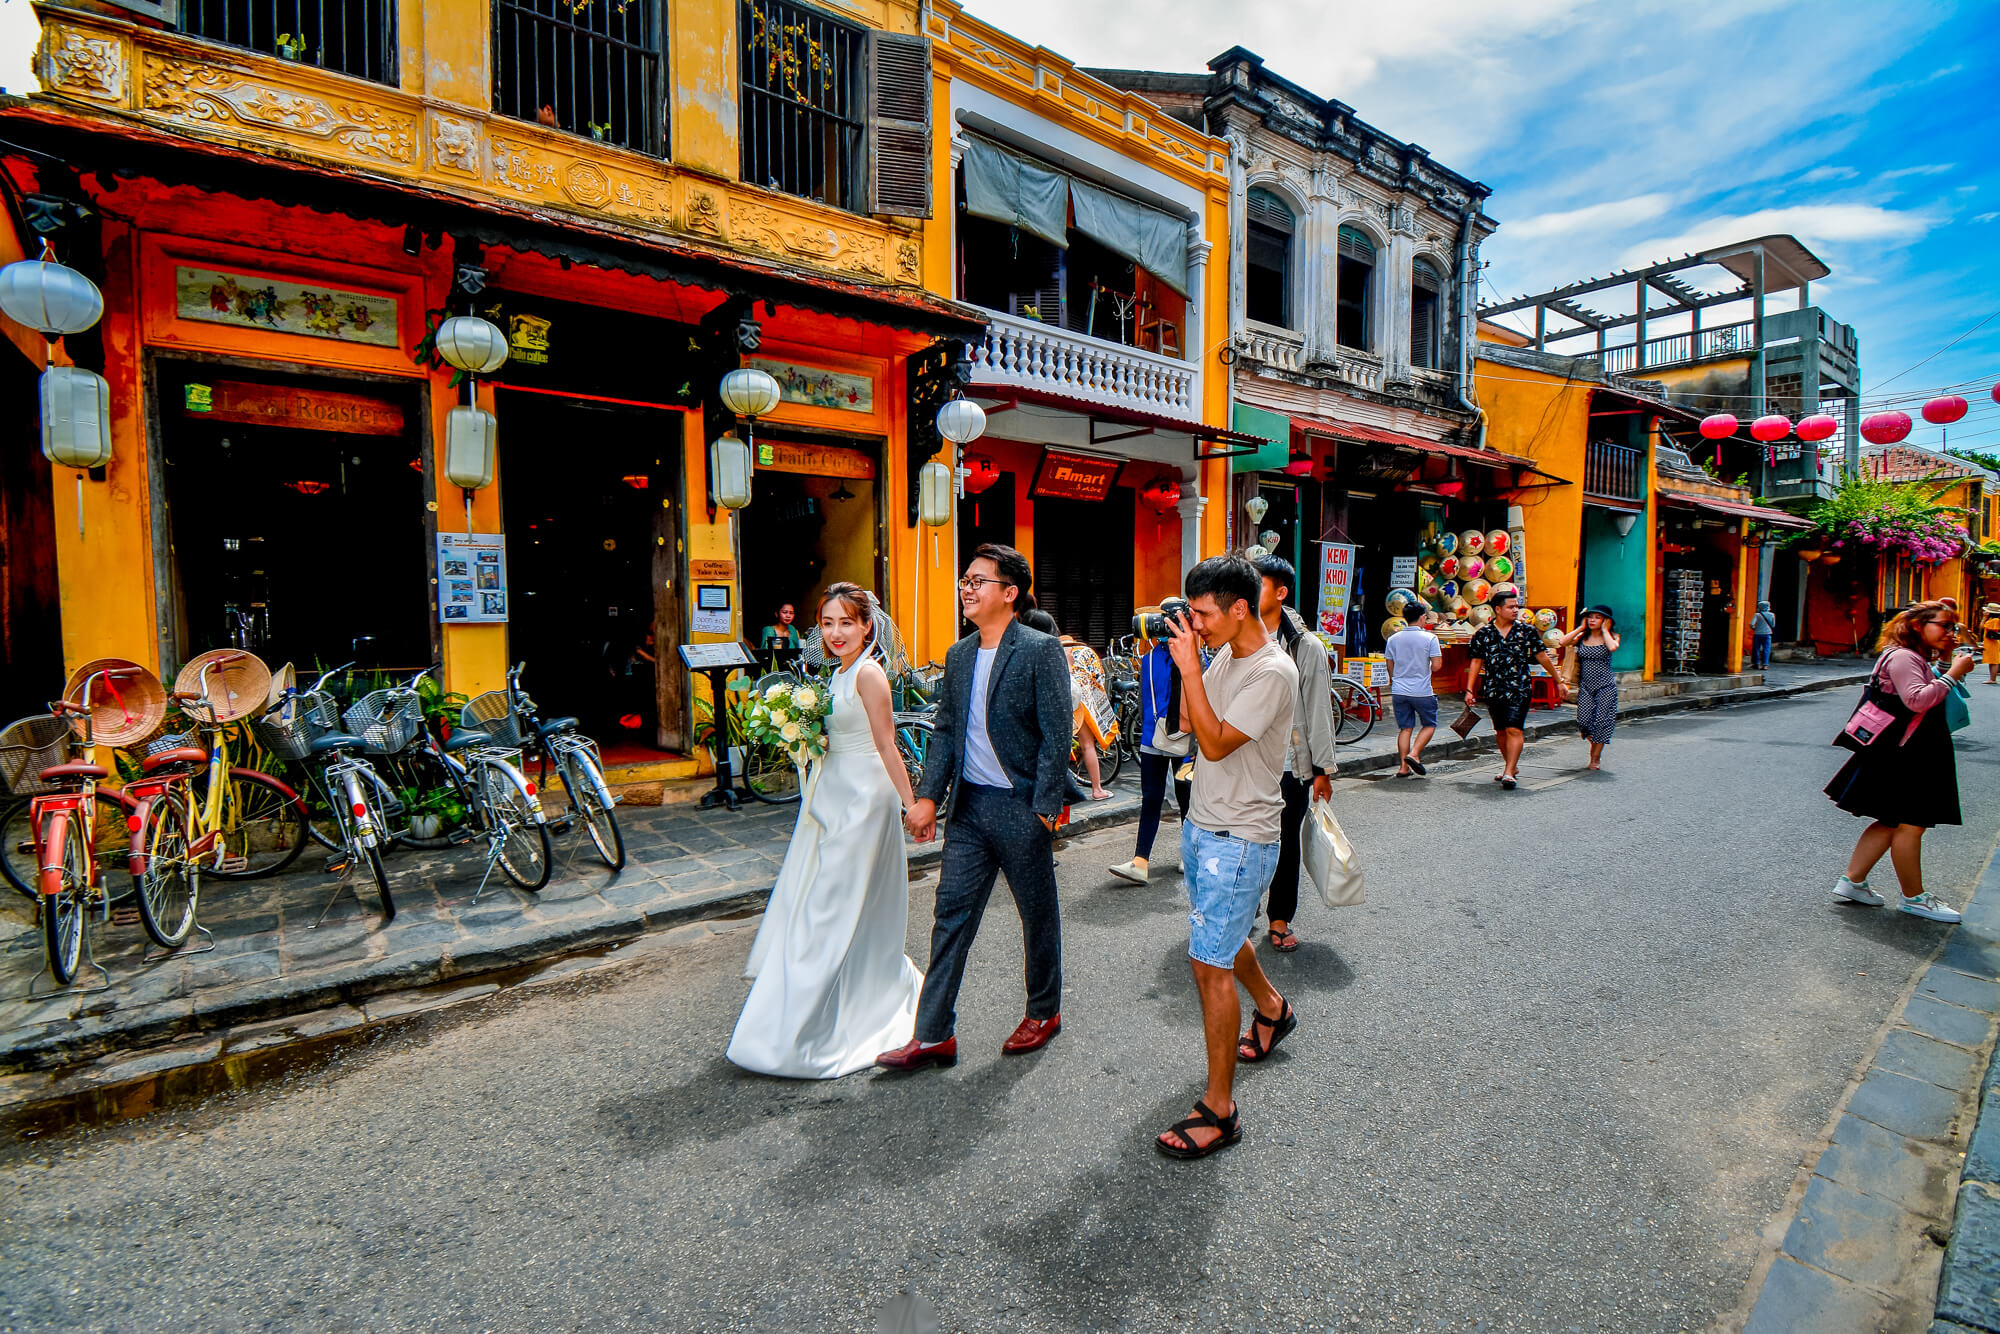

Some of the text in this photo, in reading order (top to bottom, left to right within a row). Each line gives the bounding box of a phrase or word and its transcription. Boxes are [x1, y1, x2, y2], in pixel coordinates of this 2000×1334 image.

[1055, 466, 1107, 486] Amart
[1327, 548, 1348, 565] KEM
[1325, 566, 1347, 585] KHÓI
